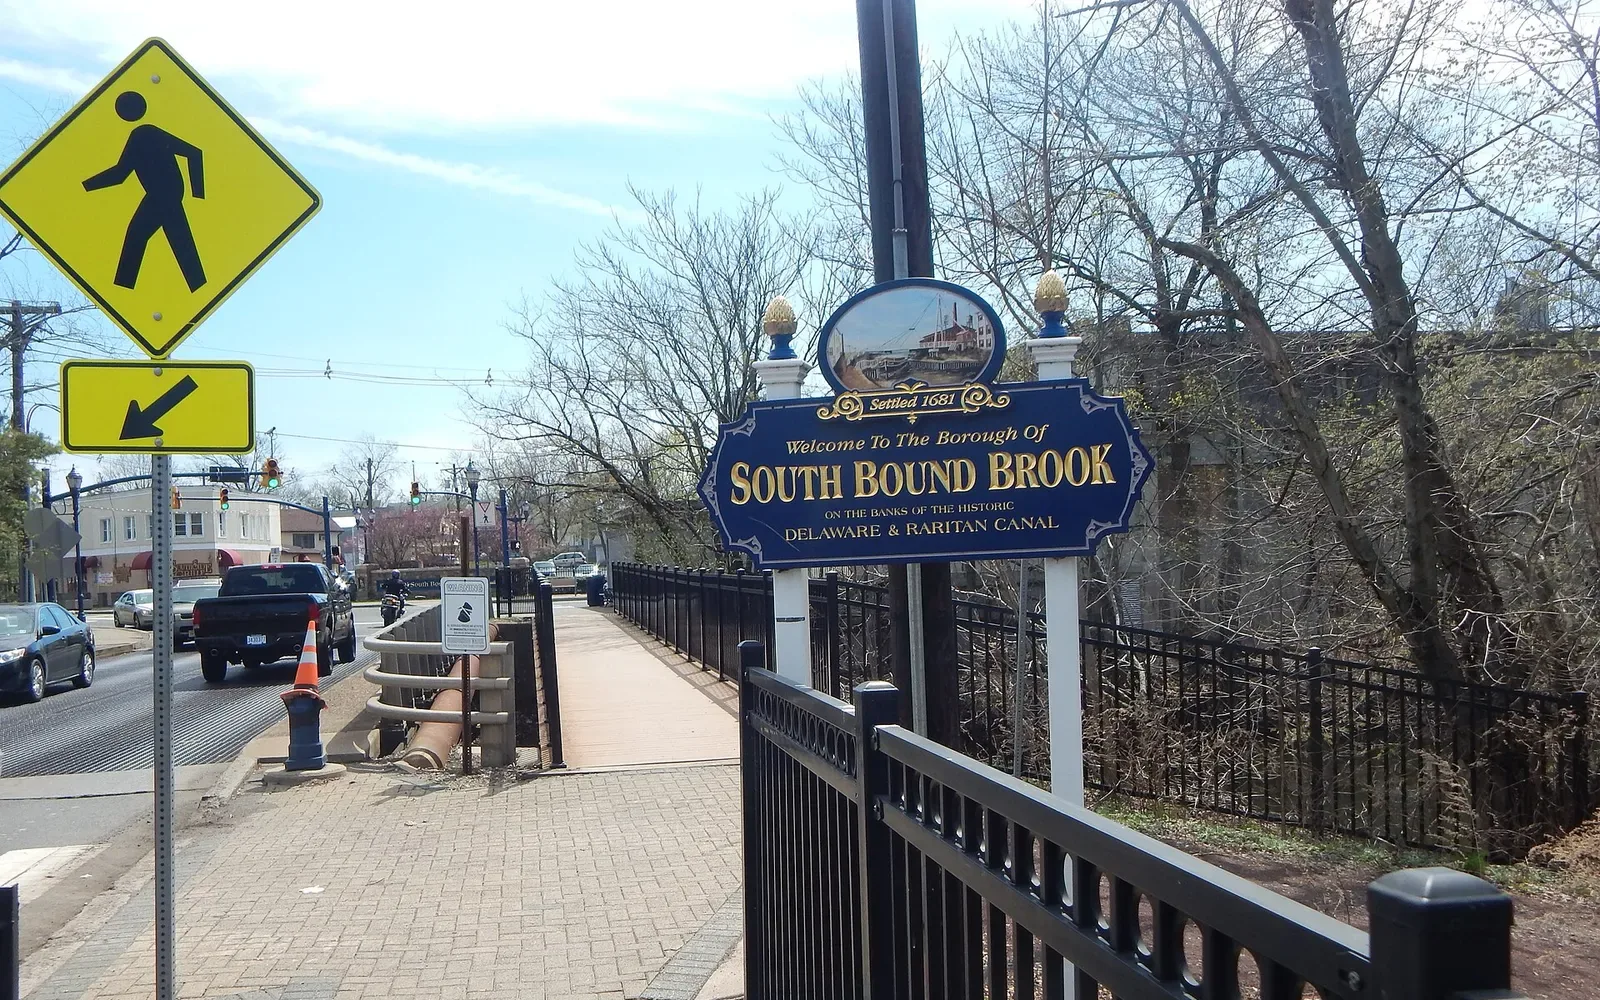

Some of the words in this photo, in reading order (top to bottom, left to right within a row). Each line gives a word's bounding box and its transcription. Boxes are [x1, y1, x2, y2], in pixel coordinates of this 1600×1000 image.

[870, 396, 918, 411] Settled
[921, 393, 955, 406] 1681
[786, 440, 865, 454] Welcome
[871, 435, 890, 448] To
[897, 433, 929, 447] The
[936, 427, 1017, 445] Borough
[1024, 424, 1049, 442] Of
[731, 462, 843, 504] SOUTH
[854, 459, 976, 497] BOUND
[988, 443, 1116, 490] BROOK
[825, 511, 840, 519] ON
[844, 510, 866, 518] THE
[871, 508, 907, 516] BANKS
[931, 505, 954, 513] THE
[959, 502, 1014, 512] HISTORIC
[785, 525, 882, 541] DELAWARE
[889, 525, 899, 536] &
[907, 520, 986, 535] RARITAN
[995, 516, 1059, 530] CANAL
